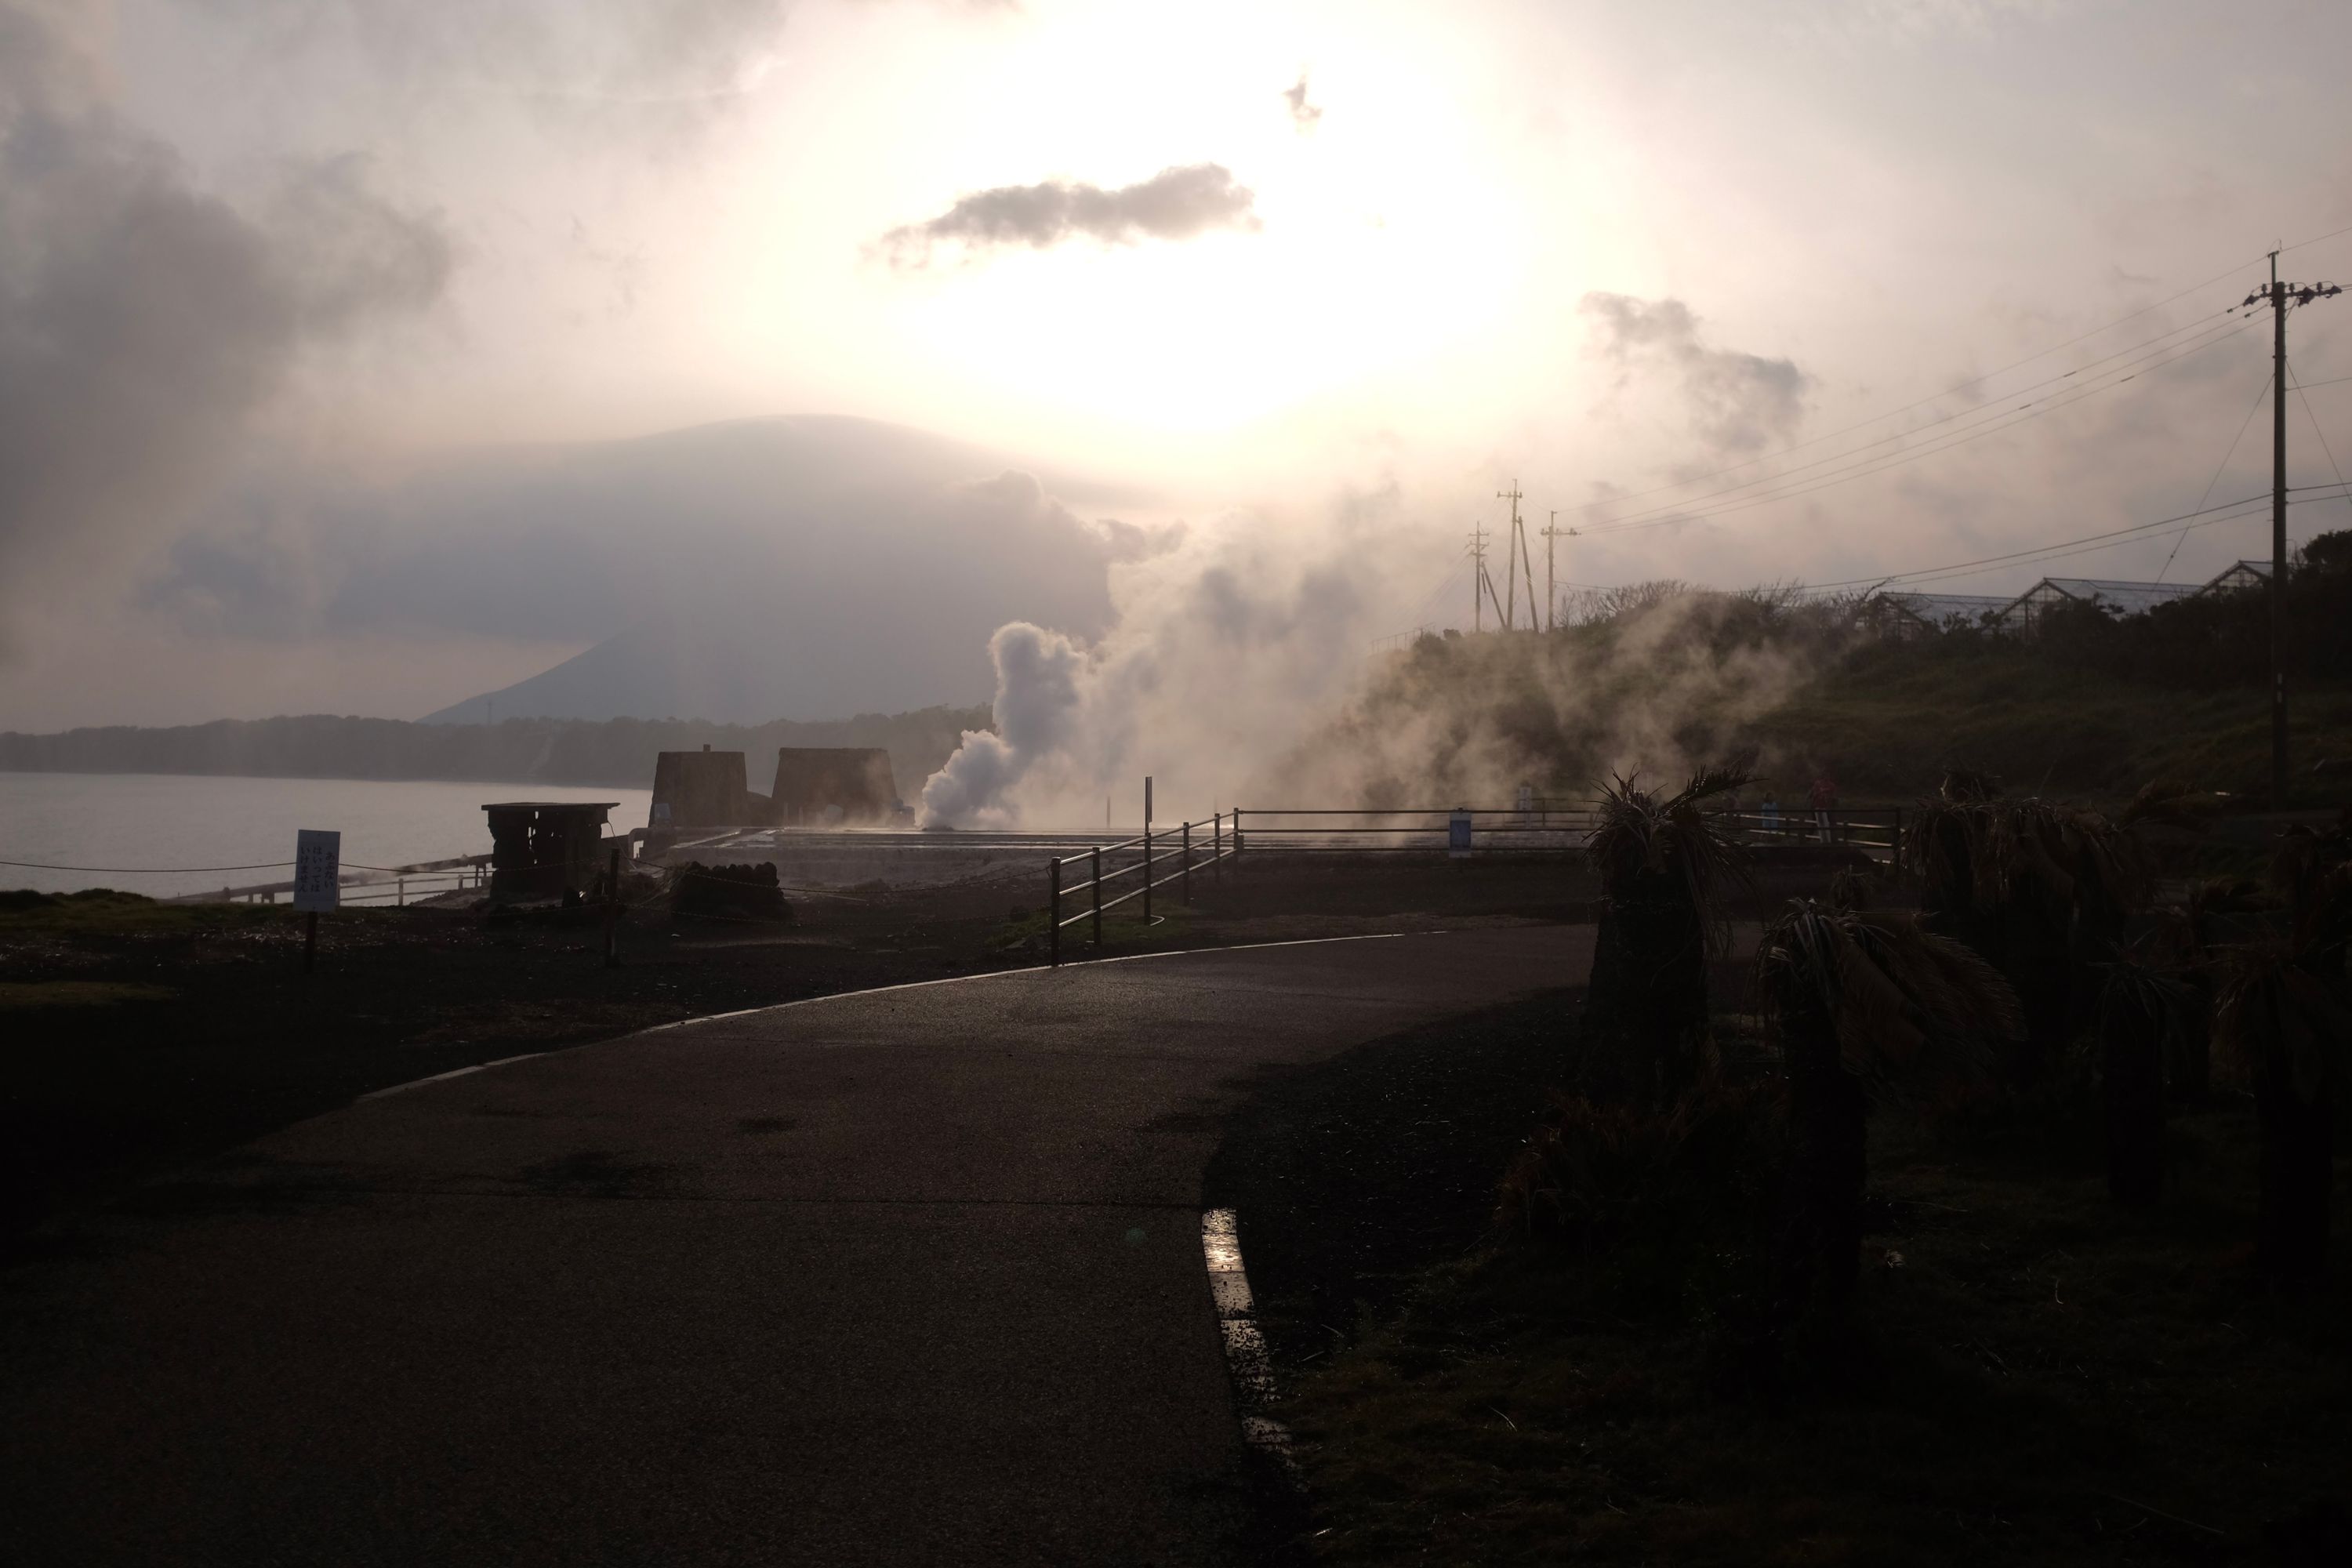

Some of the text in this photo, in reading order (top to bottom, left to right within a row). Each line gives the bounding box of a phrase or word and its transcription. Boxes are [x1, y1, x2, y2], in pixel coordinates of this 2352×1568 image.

[299, 846, 310, 892] いけません
[310, 846, 322, 892] はいっては
[325, 852, 335, 888] あぶない
